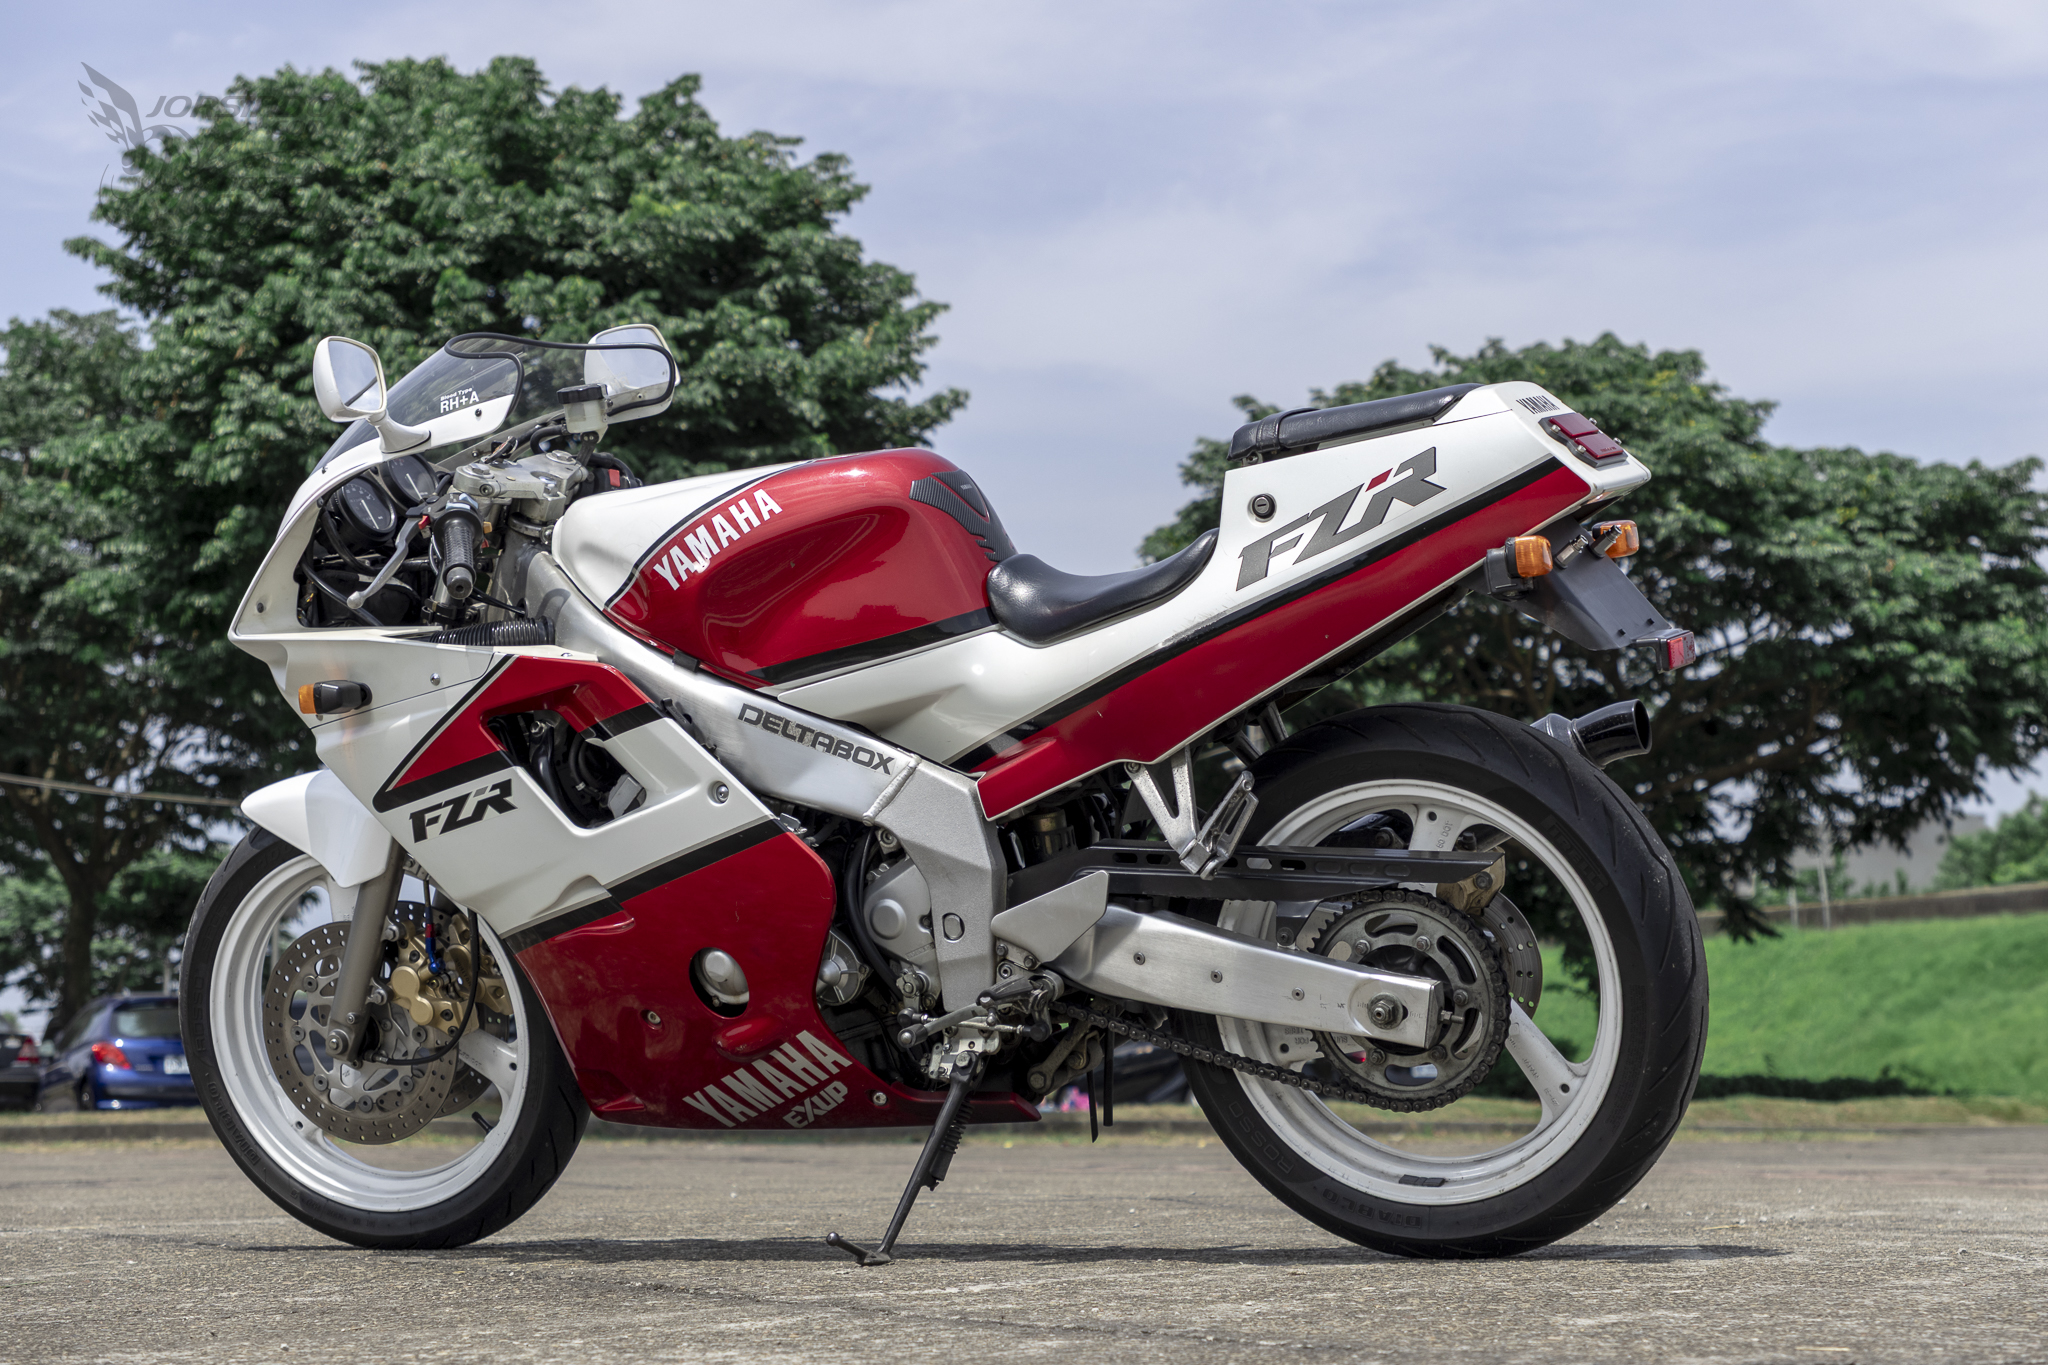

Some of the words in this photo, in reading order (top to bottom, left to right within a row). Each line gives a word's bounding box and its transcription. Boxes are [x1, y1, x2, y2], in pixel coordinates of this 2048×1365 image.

[440, 391, 457, 402] Blood
[458, 387, 473, 395] Type
[440, 391, 480, 414] RH+A
[1515, 395, 1560, 414] YAMAHA
[653, 488, 783, 591] YAMAHA
[1236, 446, 1447, 592] FZR
[737, 703, 896, 775] DELTABOX
[409, 778, 518, 843] FZR
[1541, 814, 1609, 893] PIRELLI
[193, 975, 207, 1053] ROSSO
[682, 1029, 853, 1128] YAMAHA
[782, 1080, 849, 1129] EXUP
[207, 1081, 262, 1165] DIABLO
[1229, 1102, 1296, 1174] ROSSO
[1322, 1188, 1423, 1229] DIABLO
